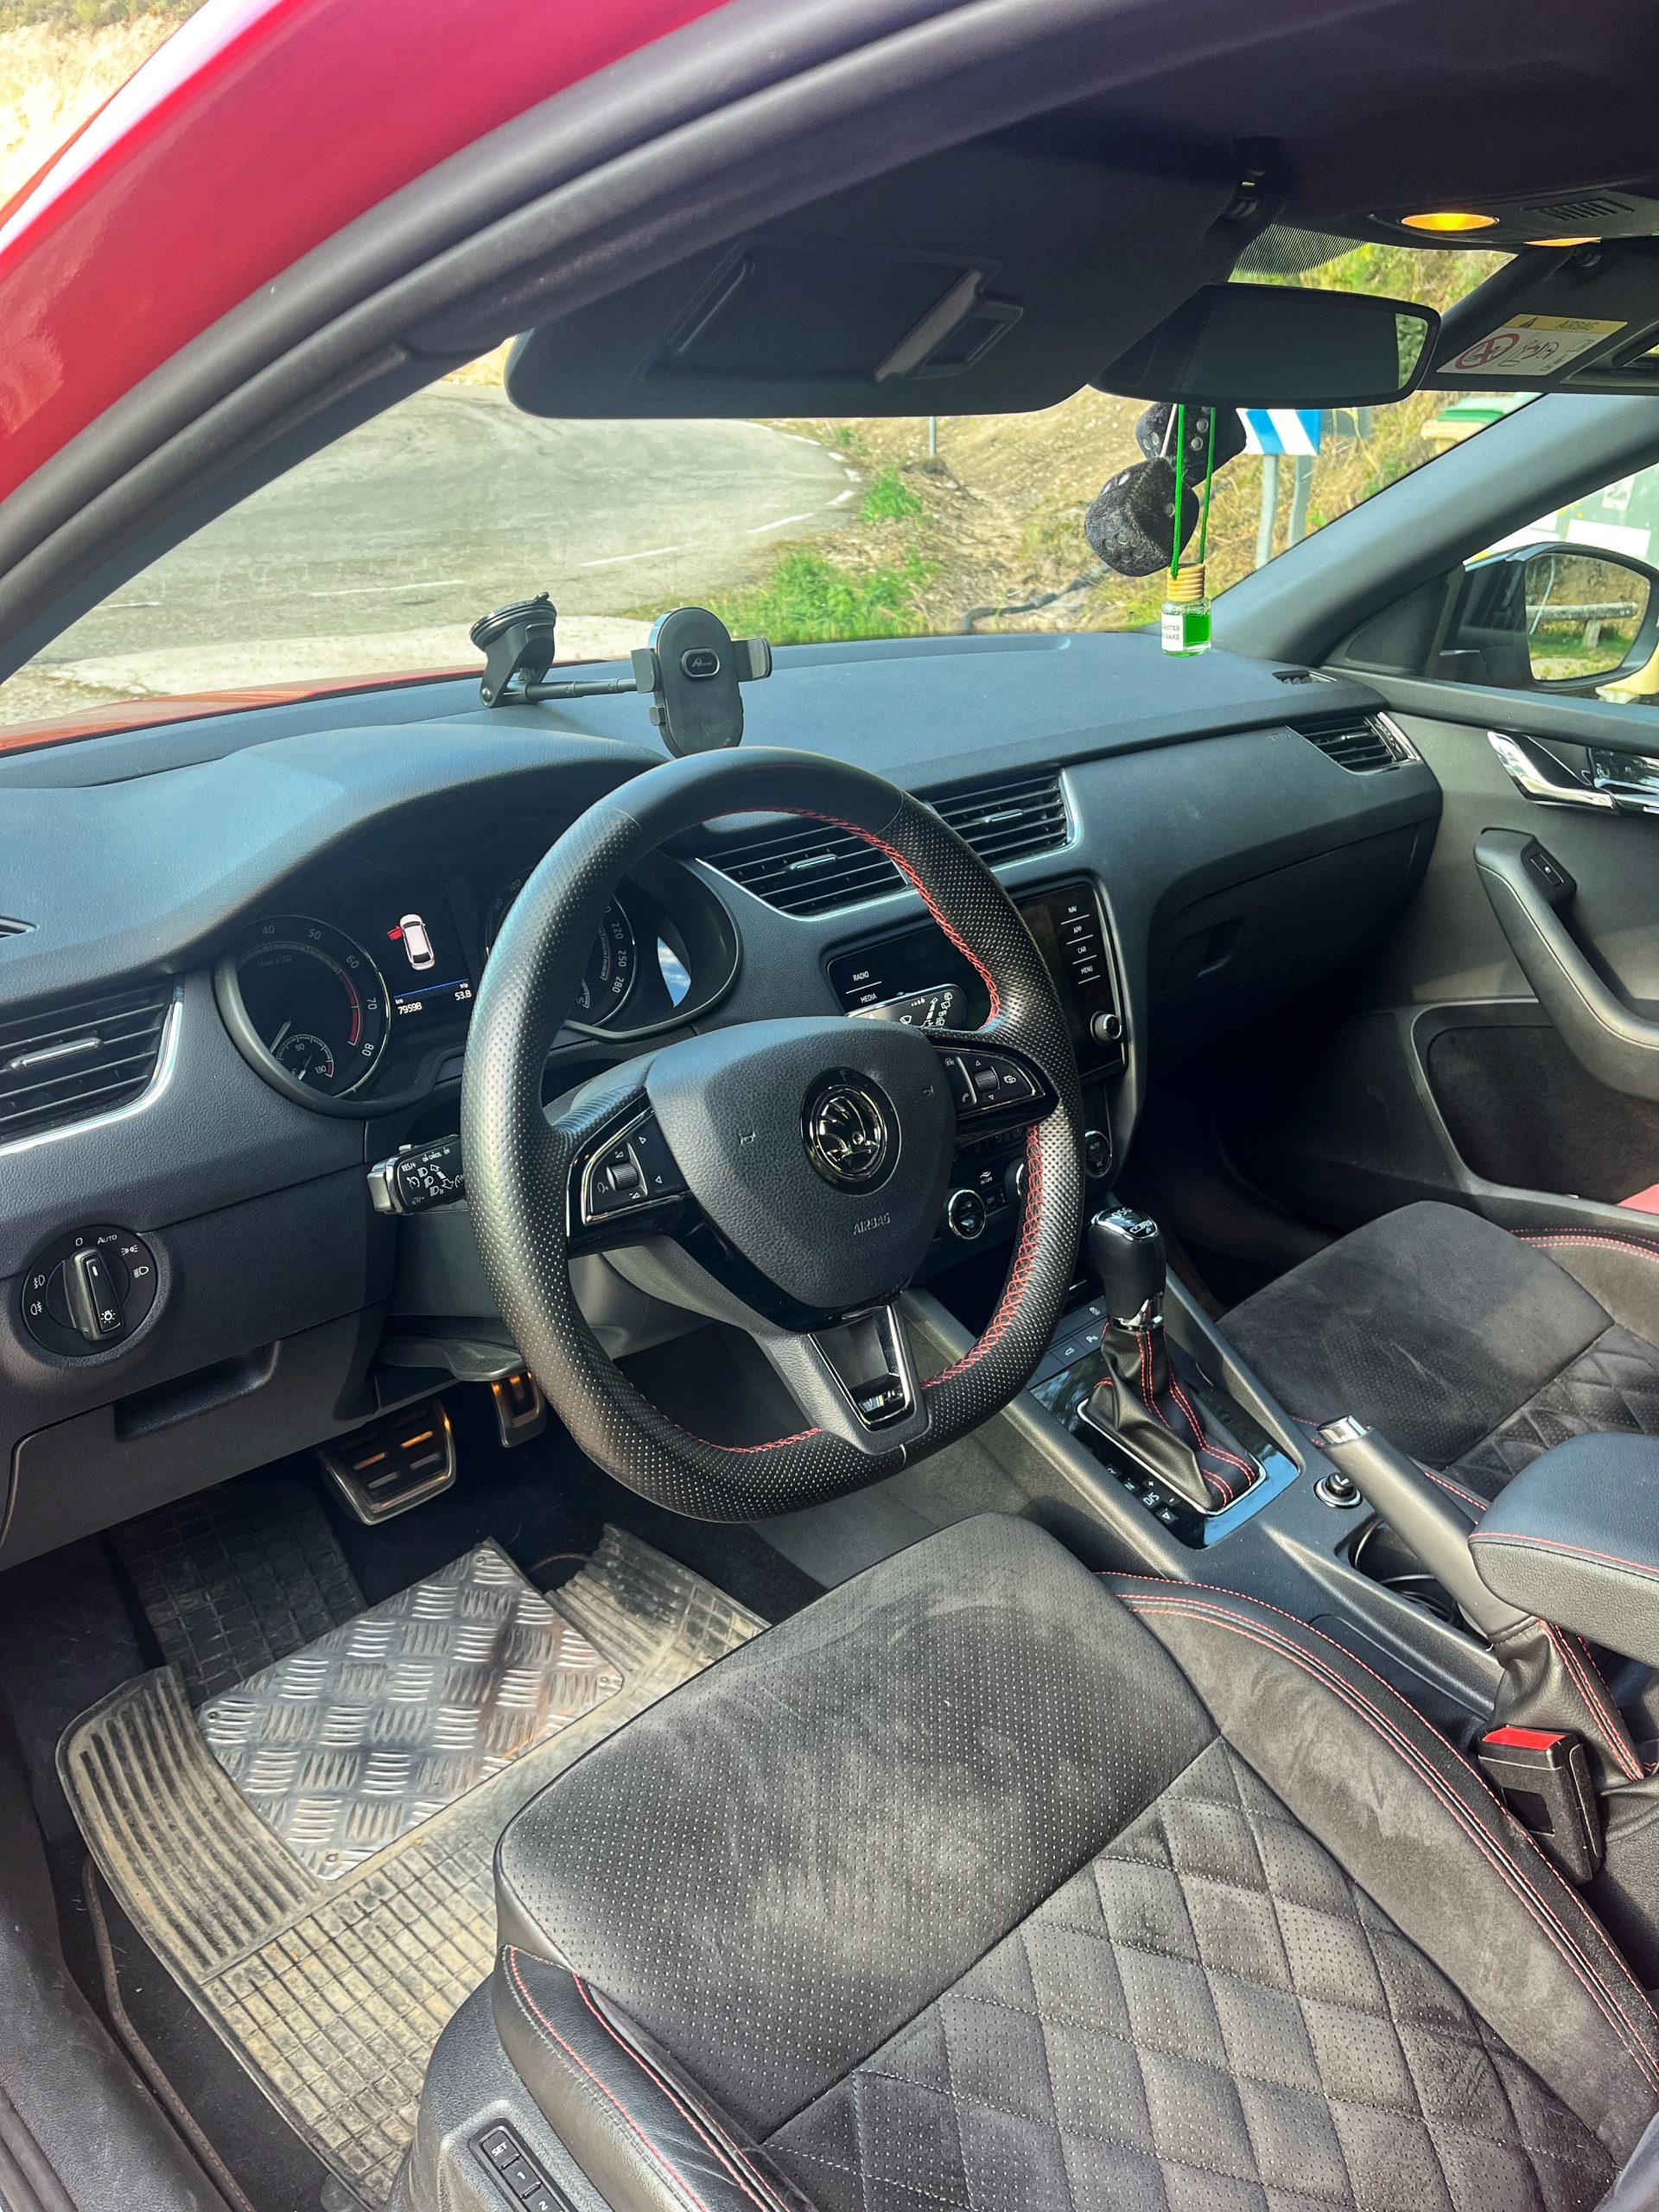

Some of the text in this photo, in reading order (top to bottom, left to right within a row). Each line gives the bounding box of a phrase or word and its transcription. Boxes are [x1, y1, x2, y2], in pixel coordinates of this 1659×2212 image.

[262, 925, 276, 934] 40
[308, 928, 321, 940] 50
[612, 922, 624, 939] 220
[1077, 945, 1087, 954] CAR
[346, 955, 359, 969] 60
[618, 950, 627, 967] 250
[1080, 965, 1093, 974] MENU
[853, 970, 869, 982] RADIO
[612, 976, 624, 994] 280
[454, 989, 472, 1001] 53.8
[860, 993, 877, 1003] MEDIA
[366, 997, 378, 1010] 70
[397, 1001, 423, 1015] 79598
[295, 1043, 305, 1052] 90
[361, 1043, 374, 1057] 80
[315, 1065, 327, 1074] 130
[853, 1212, 890, 1236] AIRBAG
[1142, 1492, 1160, 1506] D/S
[491, 2141, 507, 2157] SET
[517, 2171, 525, 2180] 1
[538, 2200, 549, 2211] 2
